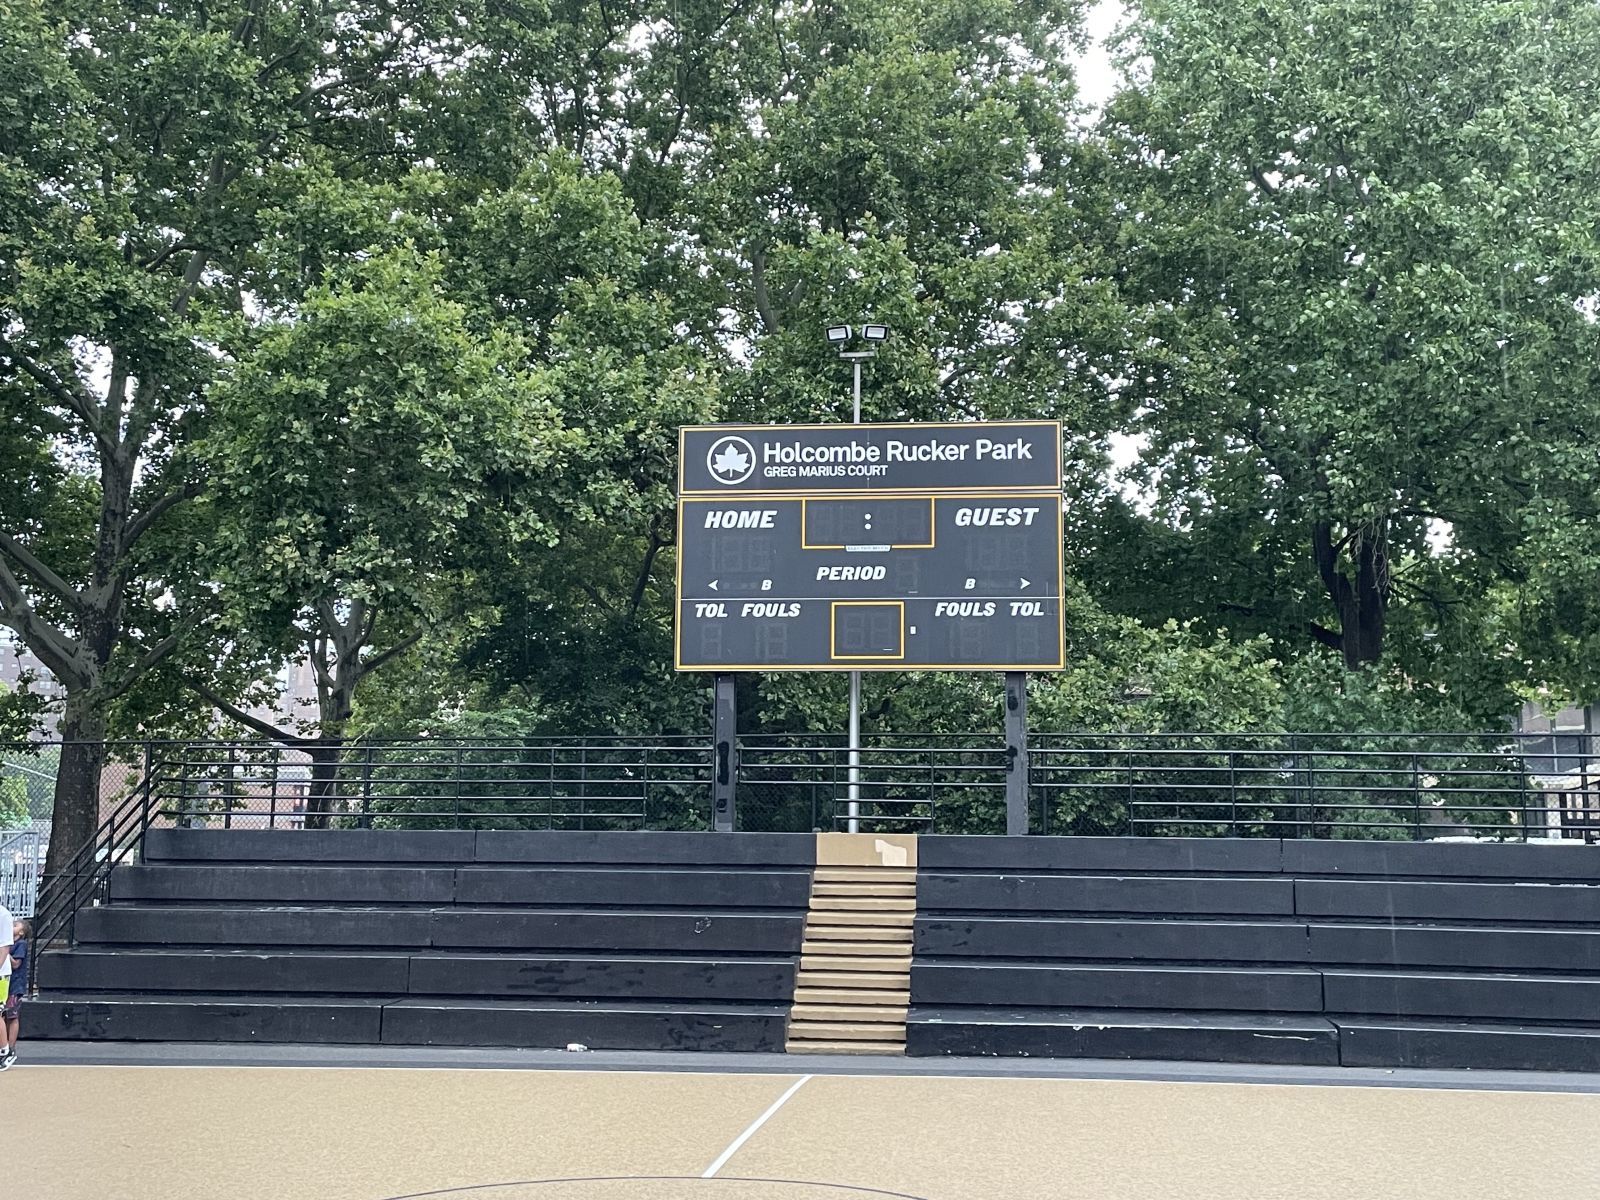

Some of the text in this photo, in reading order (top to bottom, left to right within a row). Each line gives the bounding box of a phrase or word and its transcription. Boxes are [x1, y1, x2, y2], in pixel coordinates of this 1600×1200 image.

[763, 438, 1032, 463] Holcombe Rucker Park
[764, 464, 888, 477] GREG MARIUS COURT
[704, 510, 778, 529] HOME
[955, 507, 1040, 527] GUEST
[816, 566, 887, 581] PERIOD
[760, 579, 772, 591] B
[964, 578, 976, 590] B
[695, 603, 801, 618] TOL FOULS
[935, 602, 1044, 617] FOULS TOL
